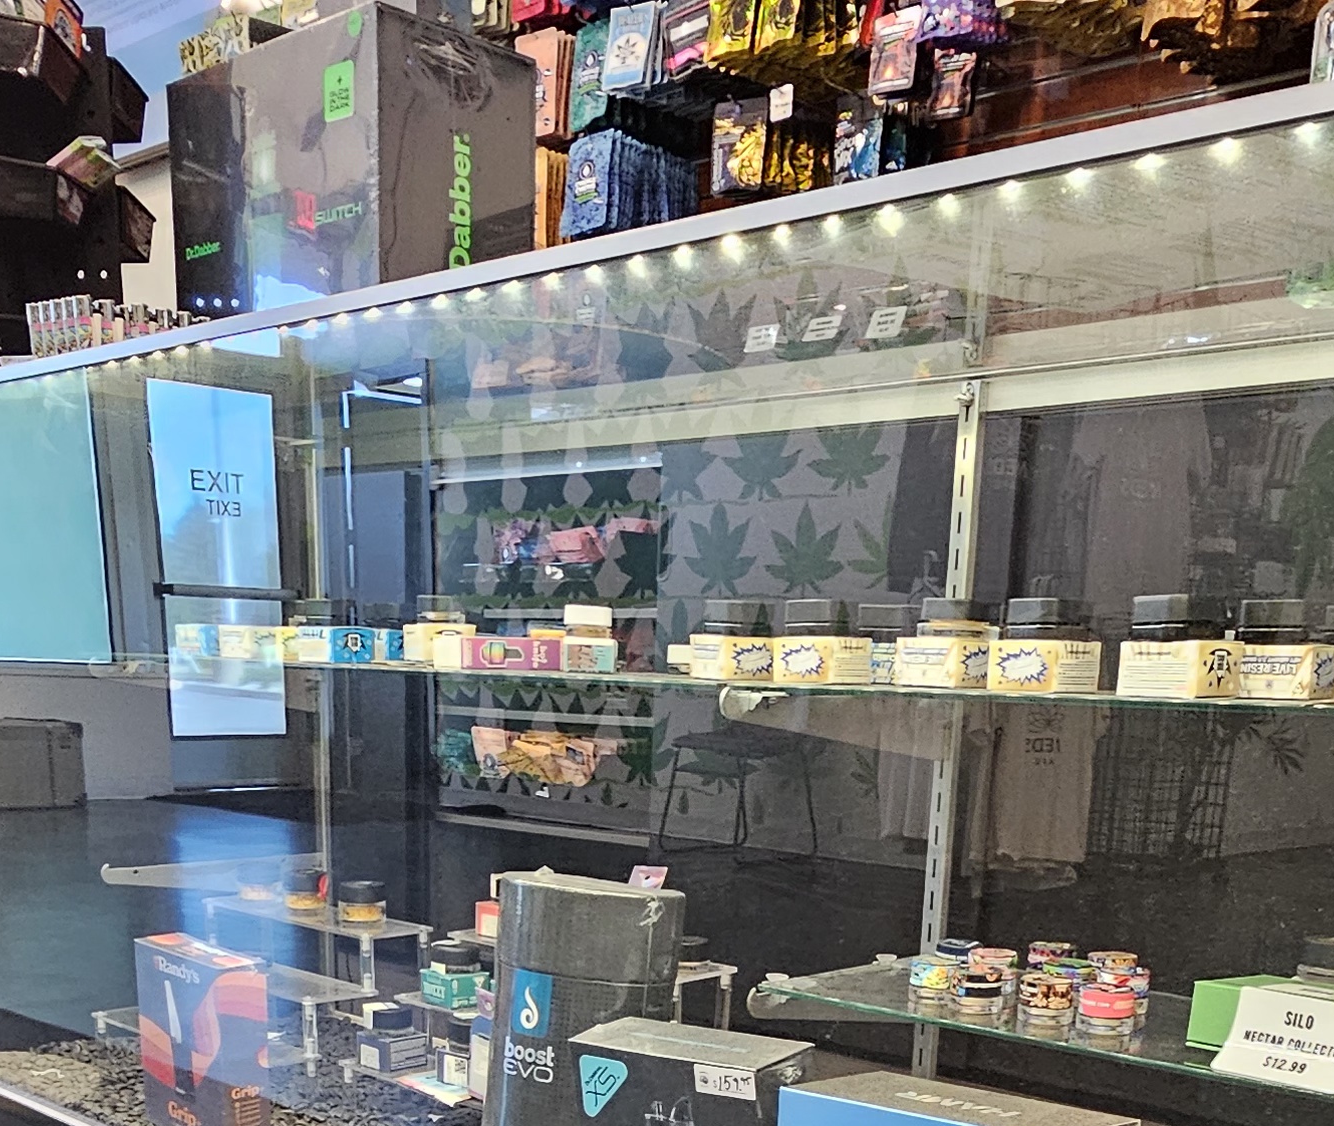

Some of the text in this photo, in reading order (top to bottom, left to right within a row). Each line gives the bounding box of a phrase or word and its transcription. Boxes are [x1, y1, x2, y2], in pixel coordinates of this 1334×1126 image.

[314, 201, 362, 226] SWITCH
[190, 469, 244, 494] EXIT
[159, 955, 200, 984] Randy's
[1284, 1010, 1315, 1030] SILO
[1243, 1030, 1284, 1046] NECTAR
[503, 1035, 556, 1067] boost
[503, 1058, 554, 1083] EVO
[1262, 1055, 1308, 1075] $12.99
